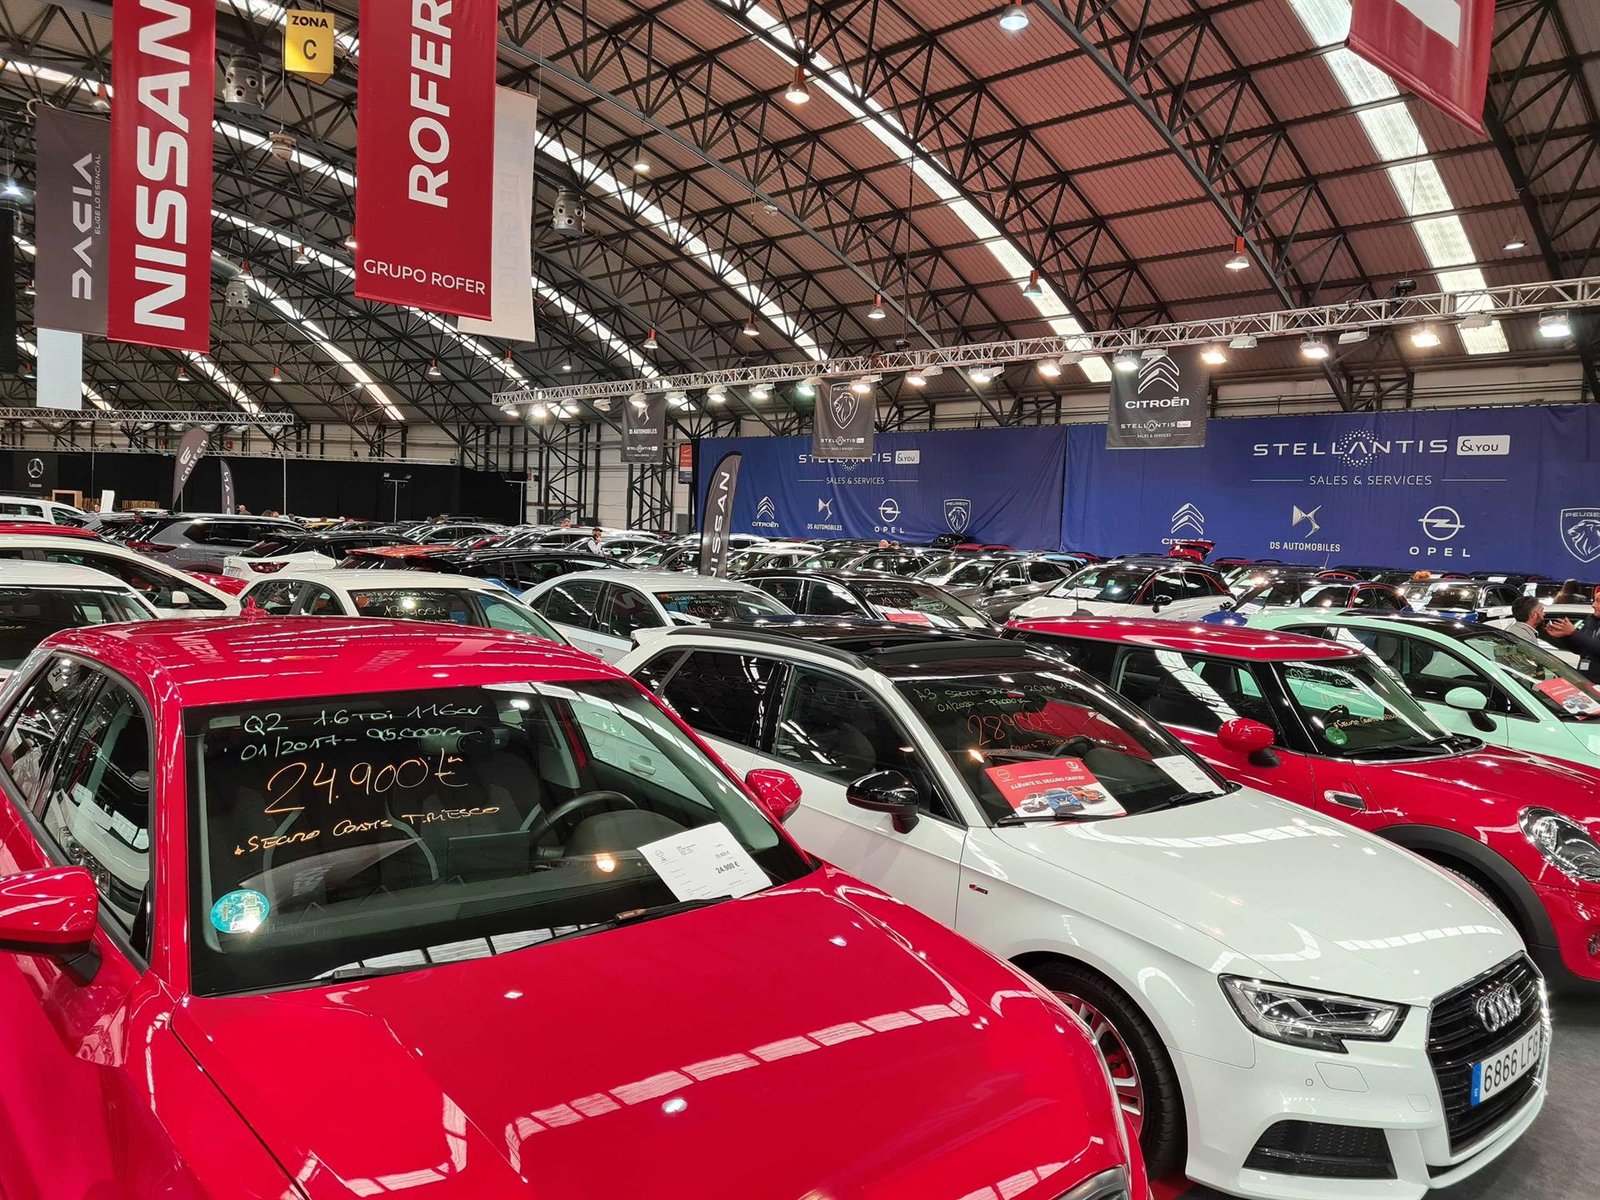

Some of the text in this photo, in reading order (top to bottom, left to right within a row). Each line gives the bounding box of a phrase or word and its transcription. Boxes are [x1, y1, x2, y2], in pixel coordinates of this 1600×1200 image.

[291, 15, 328, 28] ZONA
[303, 38, 317, 60] C
[408, 0, 452, 209] ROFER
[134, 0, 191, 331] NISSAN
[94, 197, 101, 209] LO
[72, 152, 92, 300] DACIA
[363, 259, 486, 295] GRUPO ROFER
[1124, 396, 1190, 409] CITROËN
[1120, 421, 1176, 430] STELLANTIS
[1253, 439, 1448, 456] STELLANTIS
[826, 477, 846, 485] SALES
[854, 477, 885, 485] SERVICES
[1309, 475, 1432, 485] SALES & SERVICES
[711, 471, 730, 578] NISSAN
[813, 523, 843, 531] AUTOMOBILES
[874, 526, 905, 534] OPEL
[1269, 541, 1341, 552] DS AUTOMOBILES
[1409, 546, 1471, 558] OPEL
[244, 712, 288, 735] Q2
[1484, 1030, 1538, 1093] 6866 LFG
